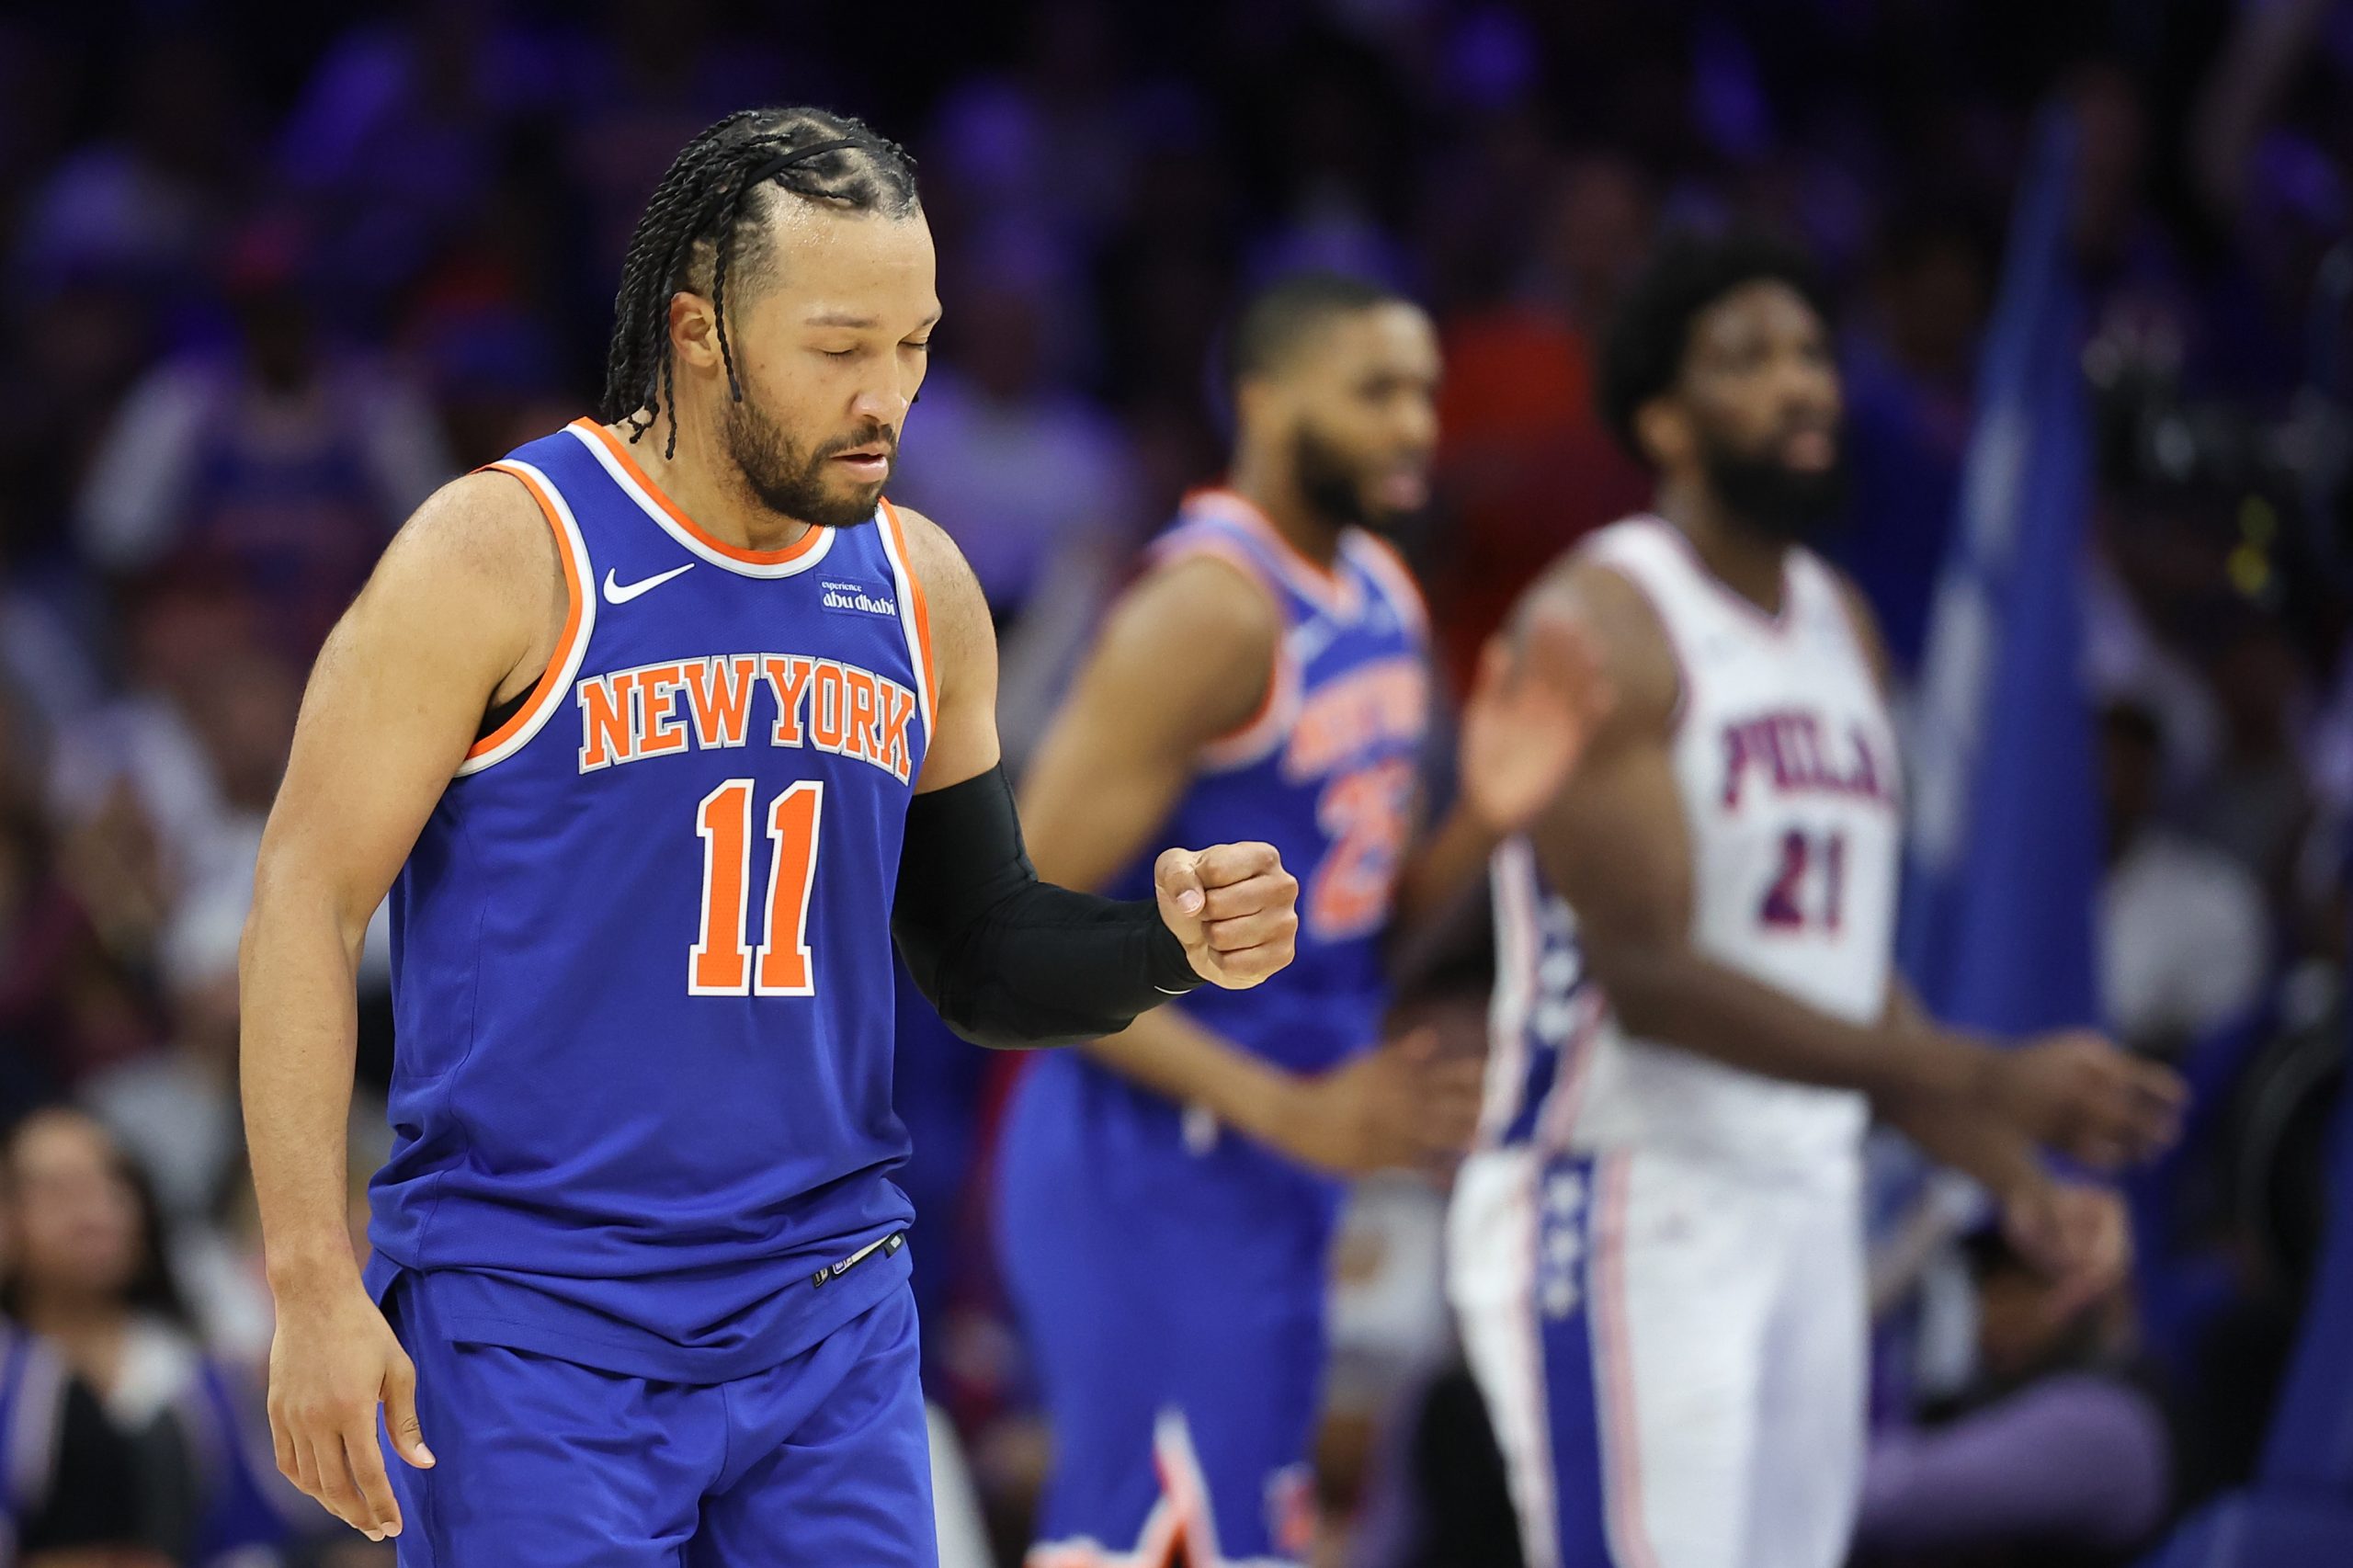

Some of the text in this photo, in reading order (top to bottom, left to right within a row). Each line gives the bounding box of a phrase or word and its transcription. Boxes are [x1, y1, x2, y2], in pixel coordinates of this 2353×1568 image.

[822, 581, 862, 592] experience
[823, 591, 896, 616] abu dhabi
[577, 653, 916, 787] NEW YORK
[688, 778, 824, 996] 11
[1757, 825, 1844, 936] 21
